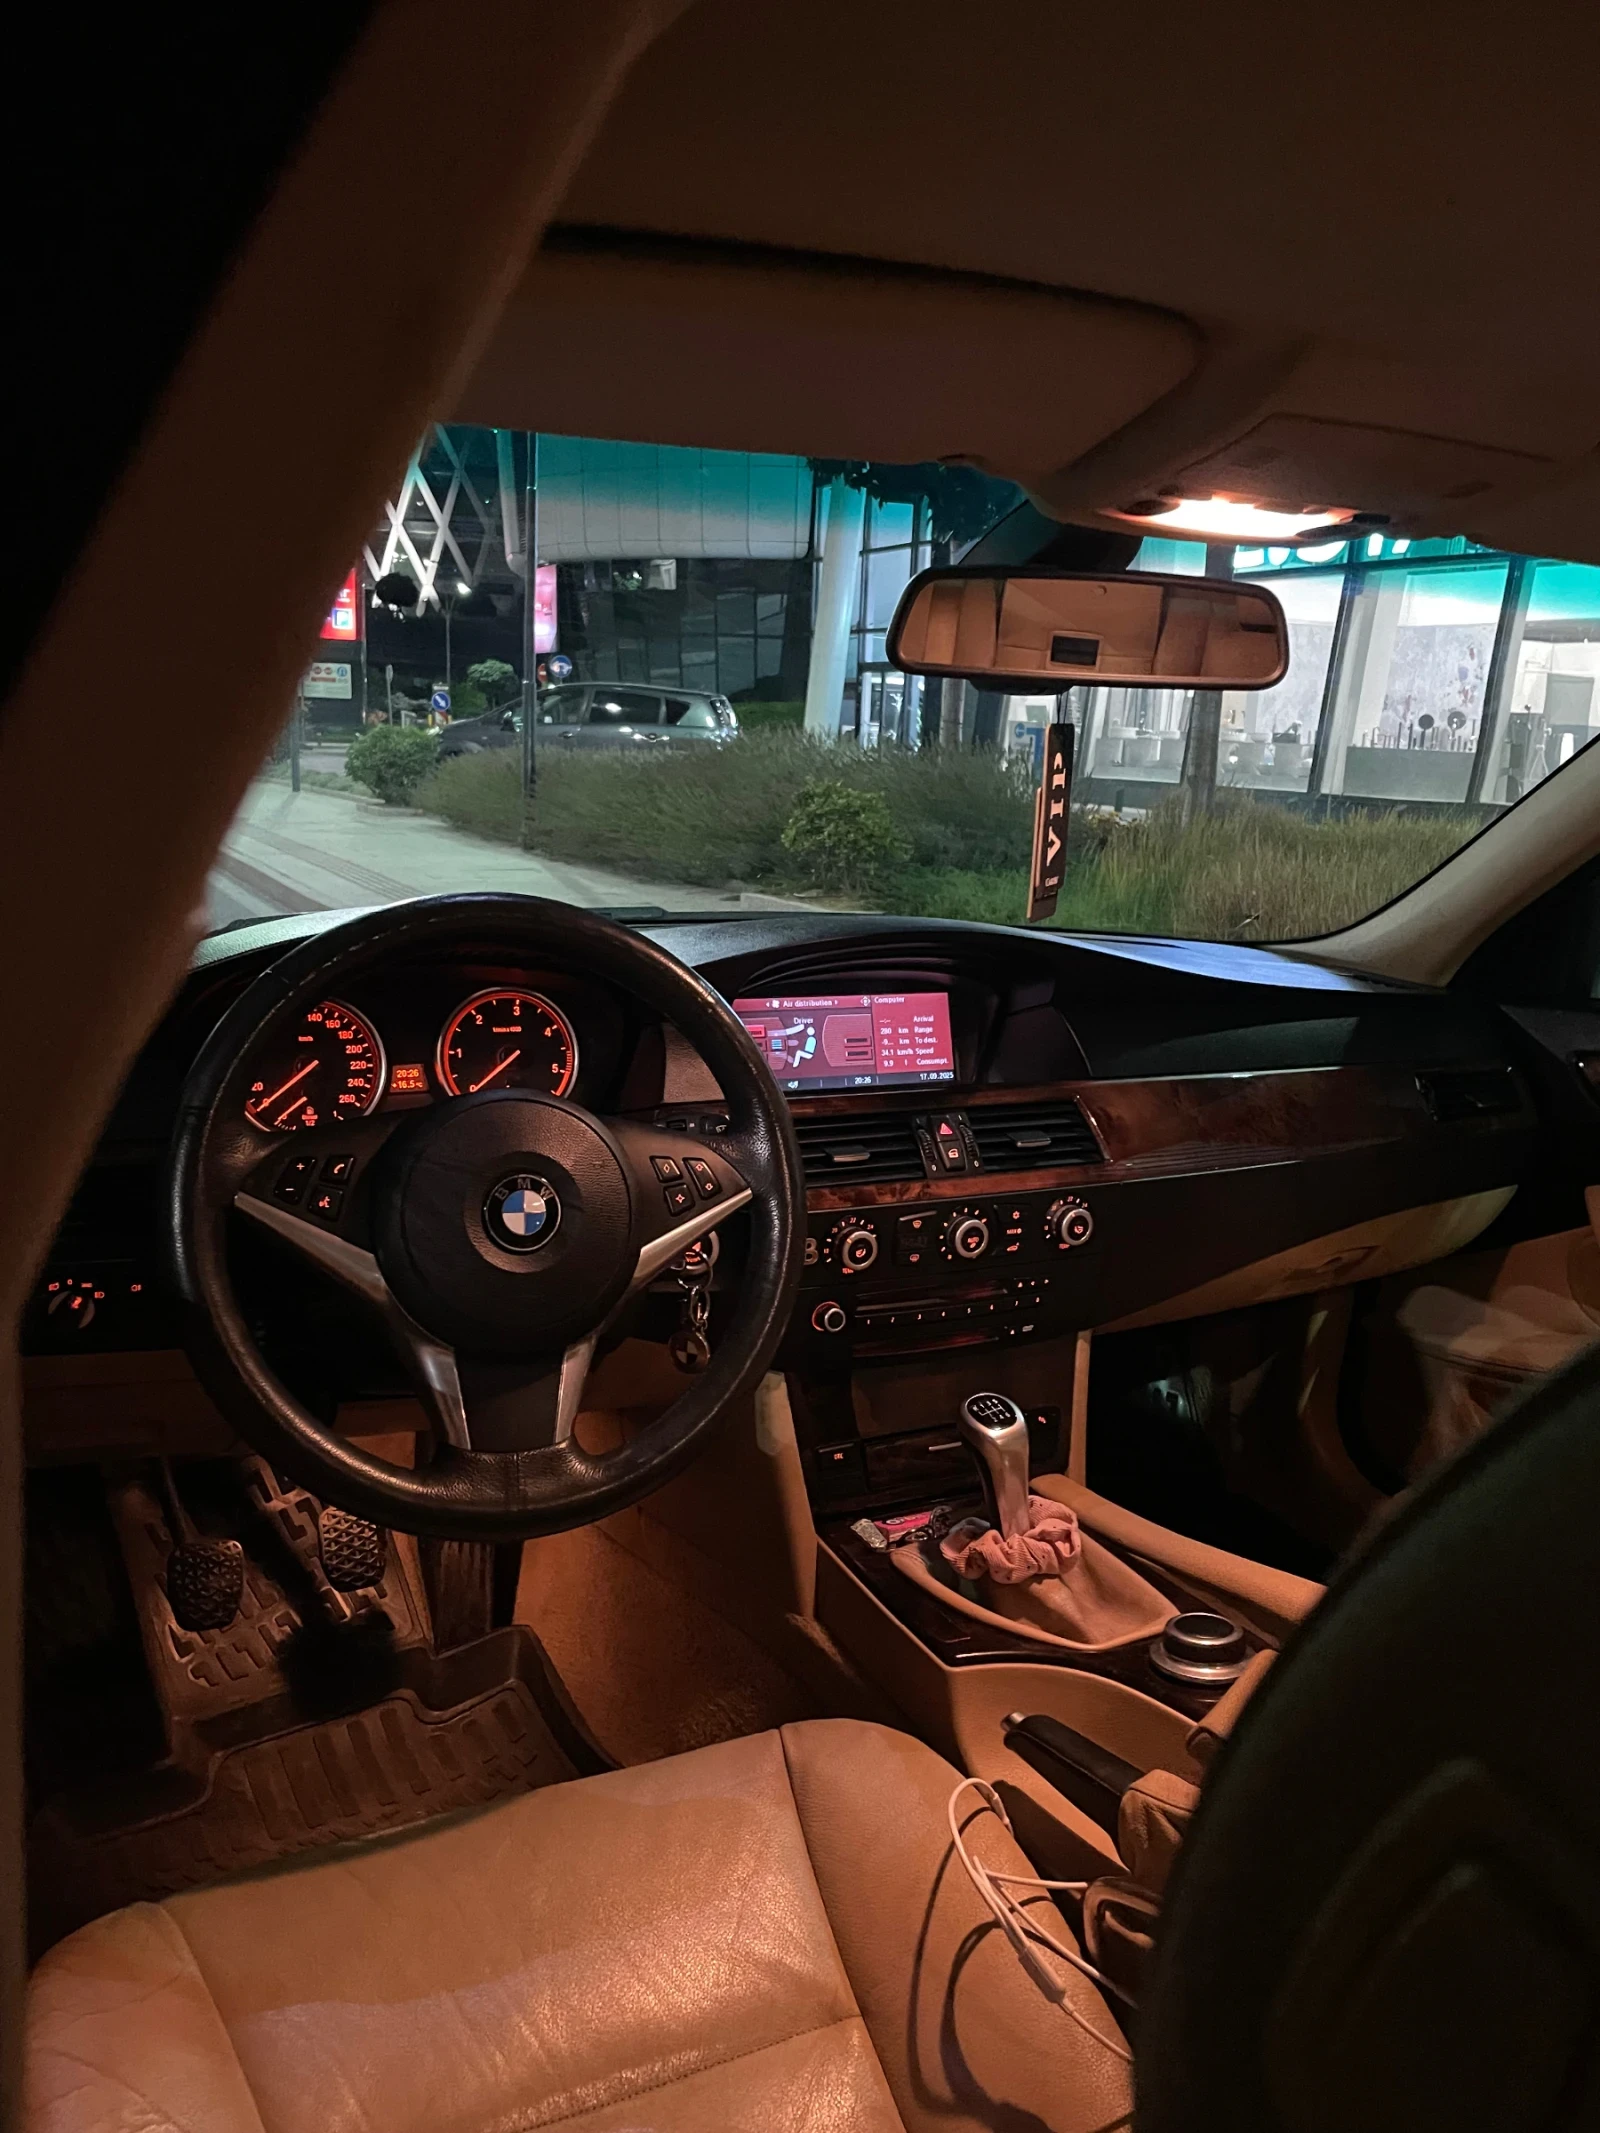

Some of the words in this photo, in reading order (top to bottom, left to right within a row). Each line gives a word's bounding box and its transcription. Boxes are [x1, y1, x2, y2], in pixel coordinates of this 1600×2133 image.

[1046, 752, 1066, 866] VIP
[795, 1000, 832, 1008] distribution
[874, 996, 905, 1004] Computer
[513, 1006, 520, 1016] 3
[307, 1013, 323, 1022] 140
[475, 1015, 483, 1025] 2
[793, 1017, 813, 1025] Driver
[325, 1020, 341, 1028] 160
[544, 1027, 552, 1037] 4
[914, 1026, 933, 1034] Range
[338, 1031, 353, 1039] 180
[345, 1045, 362, 1054] 200
[456, 1048, 462, 1058] 1
[915, 1047, 934, 1055] Speed
[350, 1061, 367, 1070] 220
[916, 1058, 949, 1066] Consumpt.
[551, 1063, 559, 1073] 5
[396, 1069, 419, 1078] 20:26
[920, 1072, 954, 1081] 17.09.2025
[347, 1078, 364, 1087] 240
[854, 1076, 872, 1085] 20:26
[339, 1094, 356, 1104] 260
[495, 1178, 554, 1201] BMW
